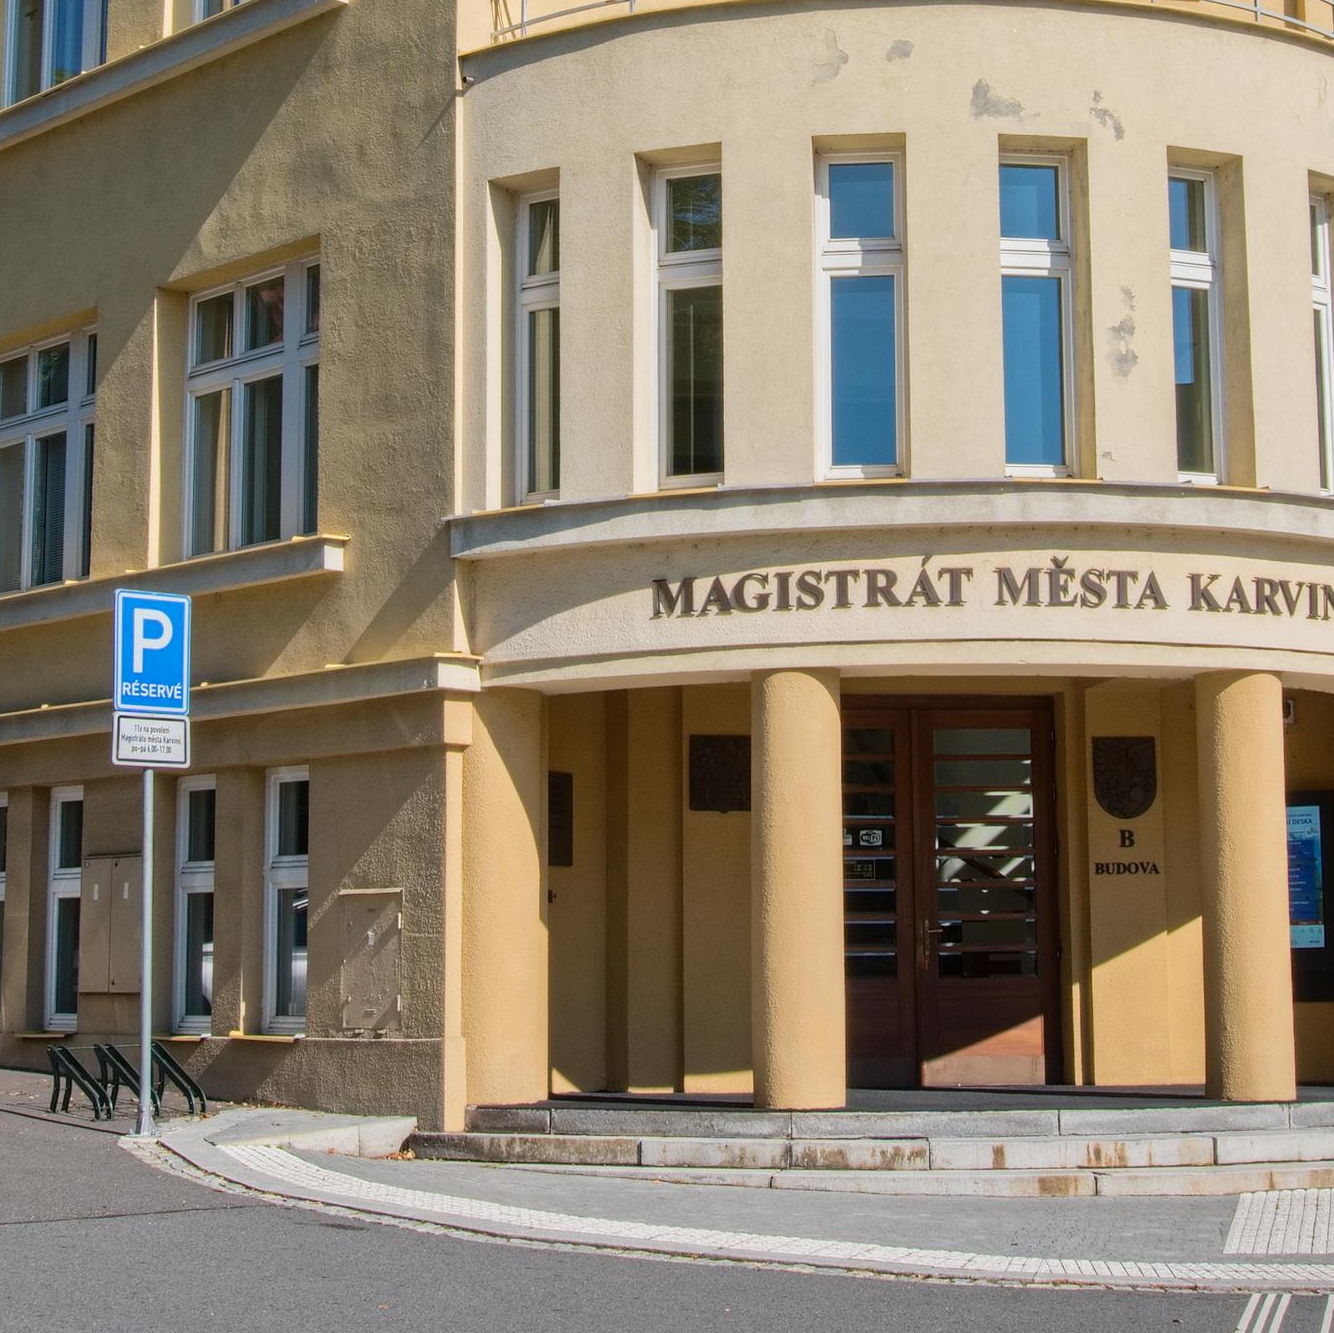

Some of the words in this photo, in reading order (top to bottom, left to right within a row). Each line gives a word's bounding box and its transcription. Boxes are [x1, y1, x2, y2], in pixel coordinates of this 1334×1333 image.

[650, 555, 974, 620] MAGISTRÁT
[993, 555, 1170, 610] MĚSTA
[133, 607, 173, 673] P
[122, 679, 183, 700] RÉSERVÉ
[1119, 829, 1135, 848] B
[1094, 861, 1161, 875] BUDOVA
